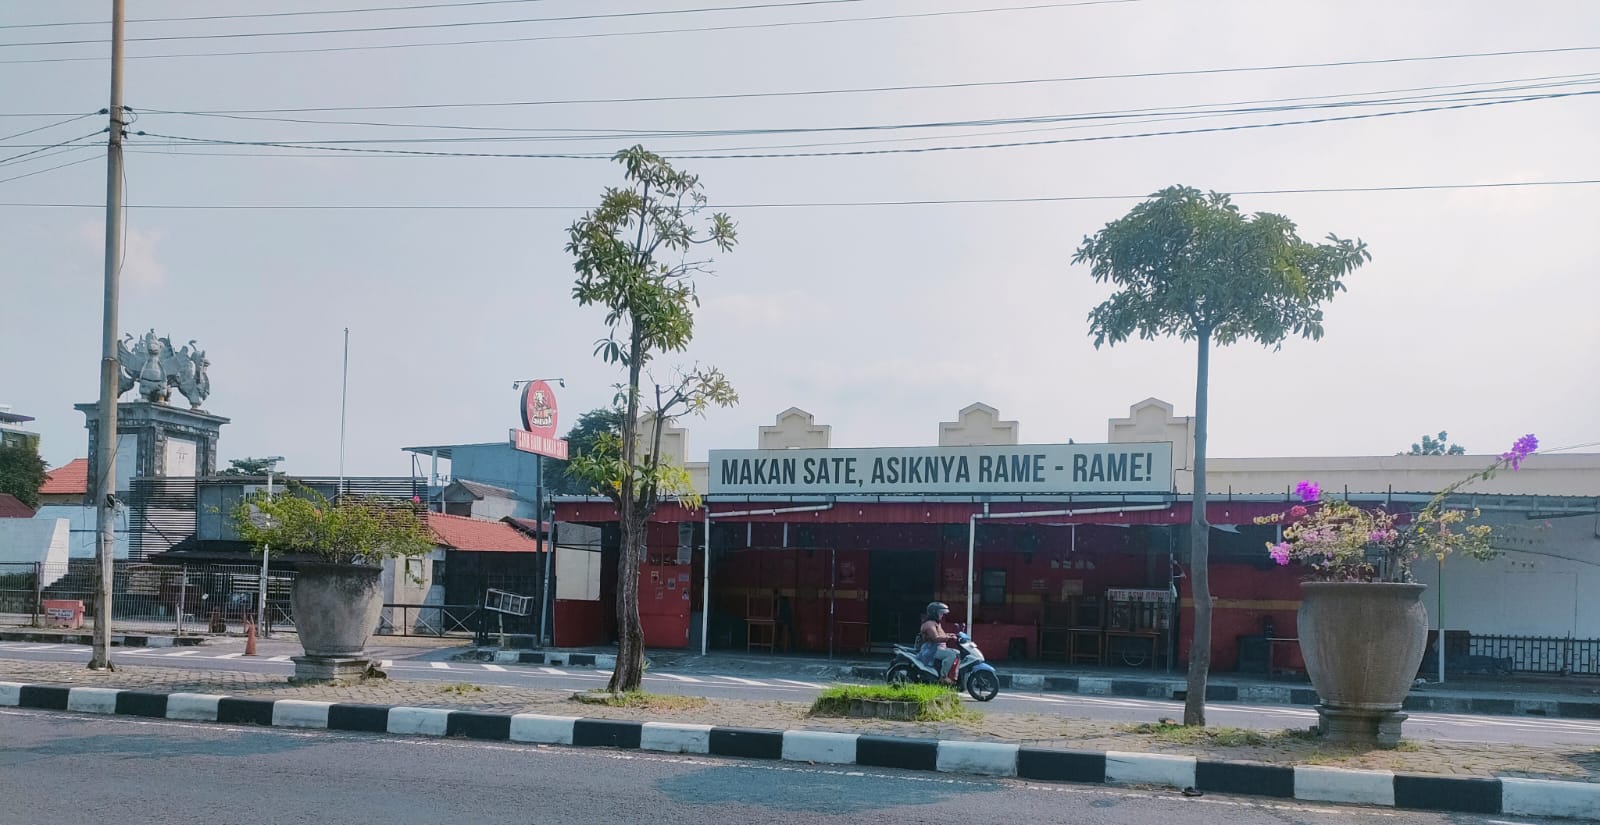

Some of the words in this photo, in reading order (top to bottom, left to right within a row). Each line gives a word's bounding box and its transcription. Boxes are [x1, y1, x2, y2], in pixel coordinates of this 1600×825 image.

[721, 458, 796, 485] MAKAN
[803, 457, 864, 487] SATE,
[871, 455, 970, 484] ASIKNYA
[978, 454, 1047, 483] RAME
[1072, 452, 1153, 482] RAME!
